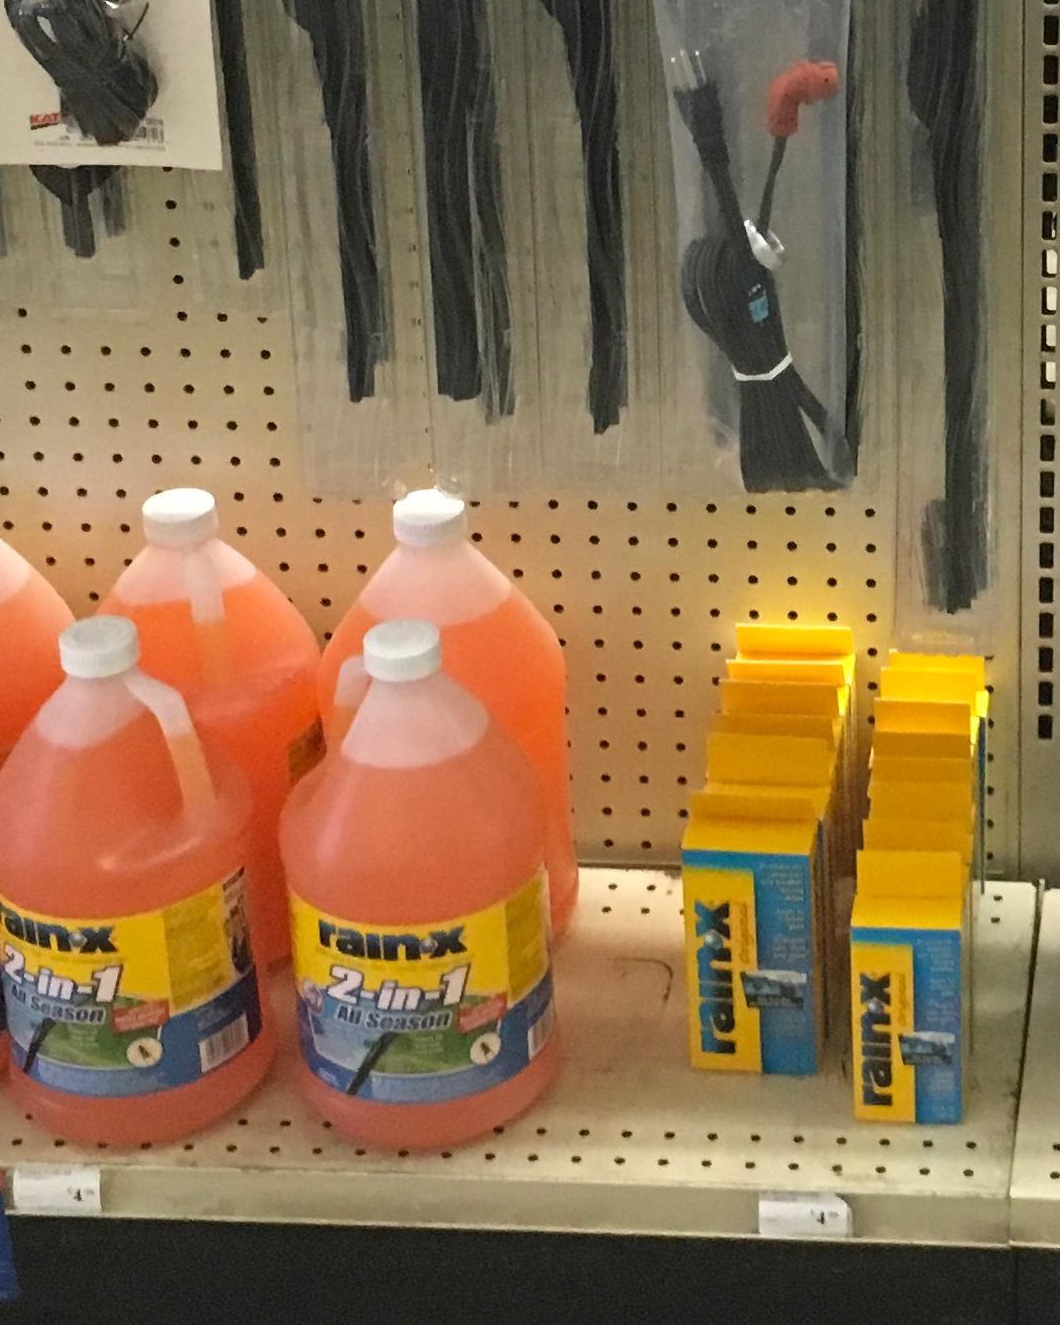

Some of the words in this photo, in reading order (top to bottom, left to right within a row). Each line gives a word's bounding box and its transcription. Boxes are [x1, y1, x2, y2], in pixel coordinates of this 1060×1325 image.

[31, 112, 60, 125] KAT
[3, 943, 123, 1004] 2-in-1
[327, 963, 471, 1011] 2-in-1
